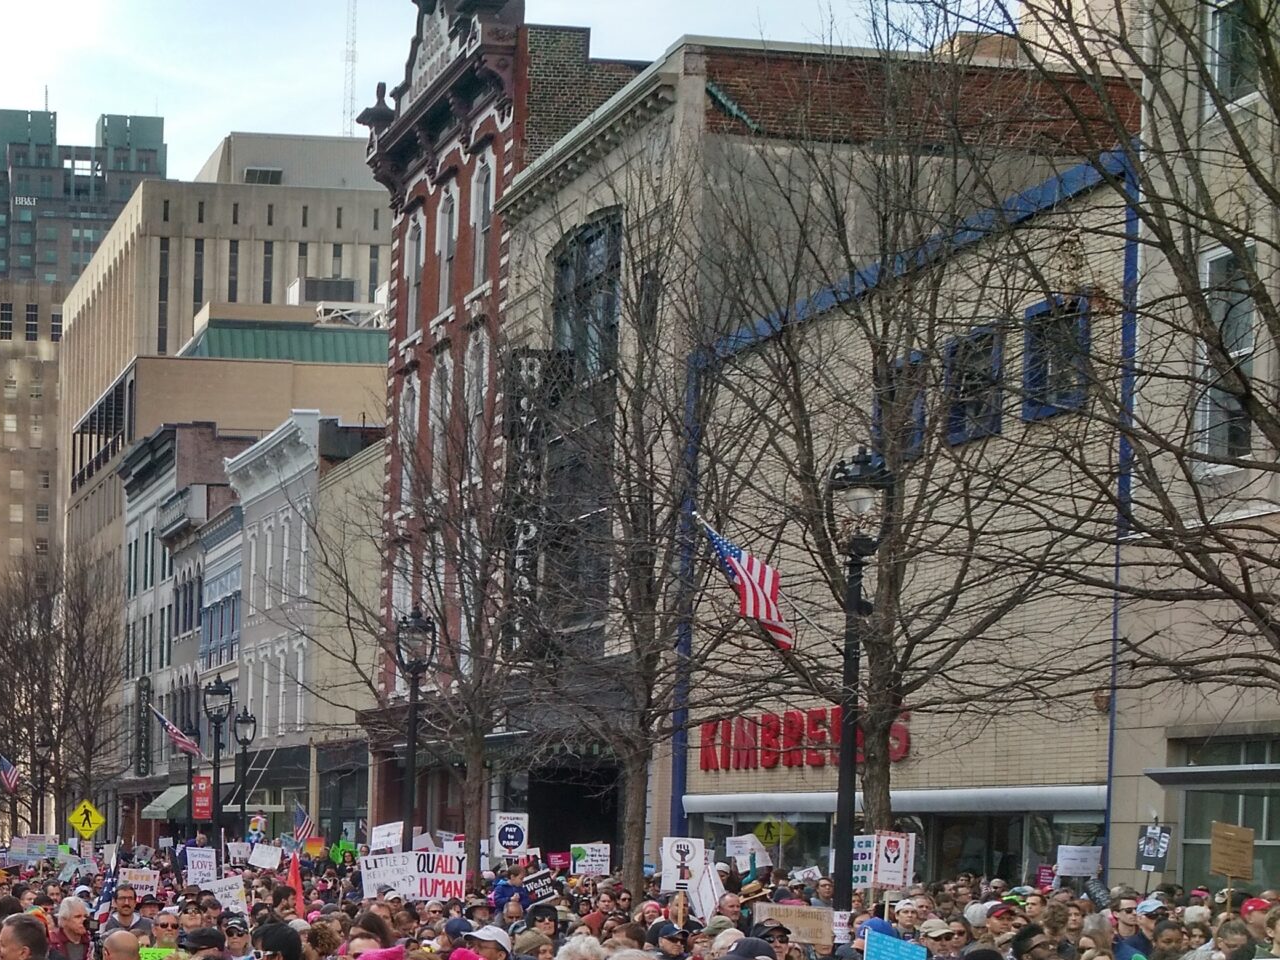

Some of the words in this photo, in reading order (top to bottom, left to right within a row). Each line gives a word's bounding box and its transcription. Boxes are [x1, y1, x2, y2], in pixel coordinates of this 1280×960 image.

[191, 861, 214, 870] LOVE
[415, 853, 466, 874] QUALLY
[535, 886, 553, 898] This
